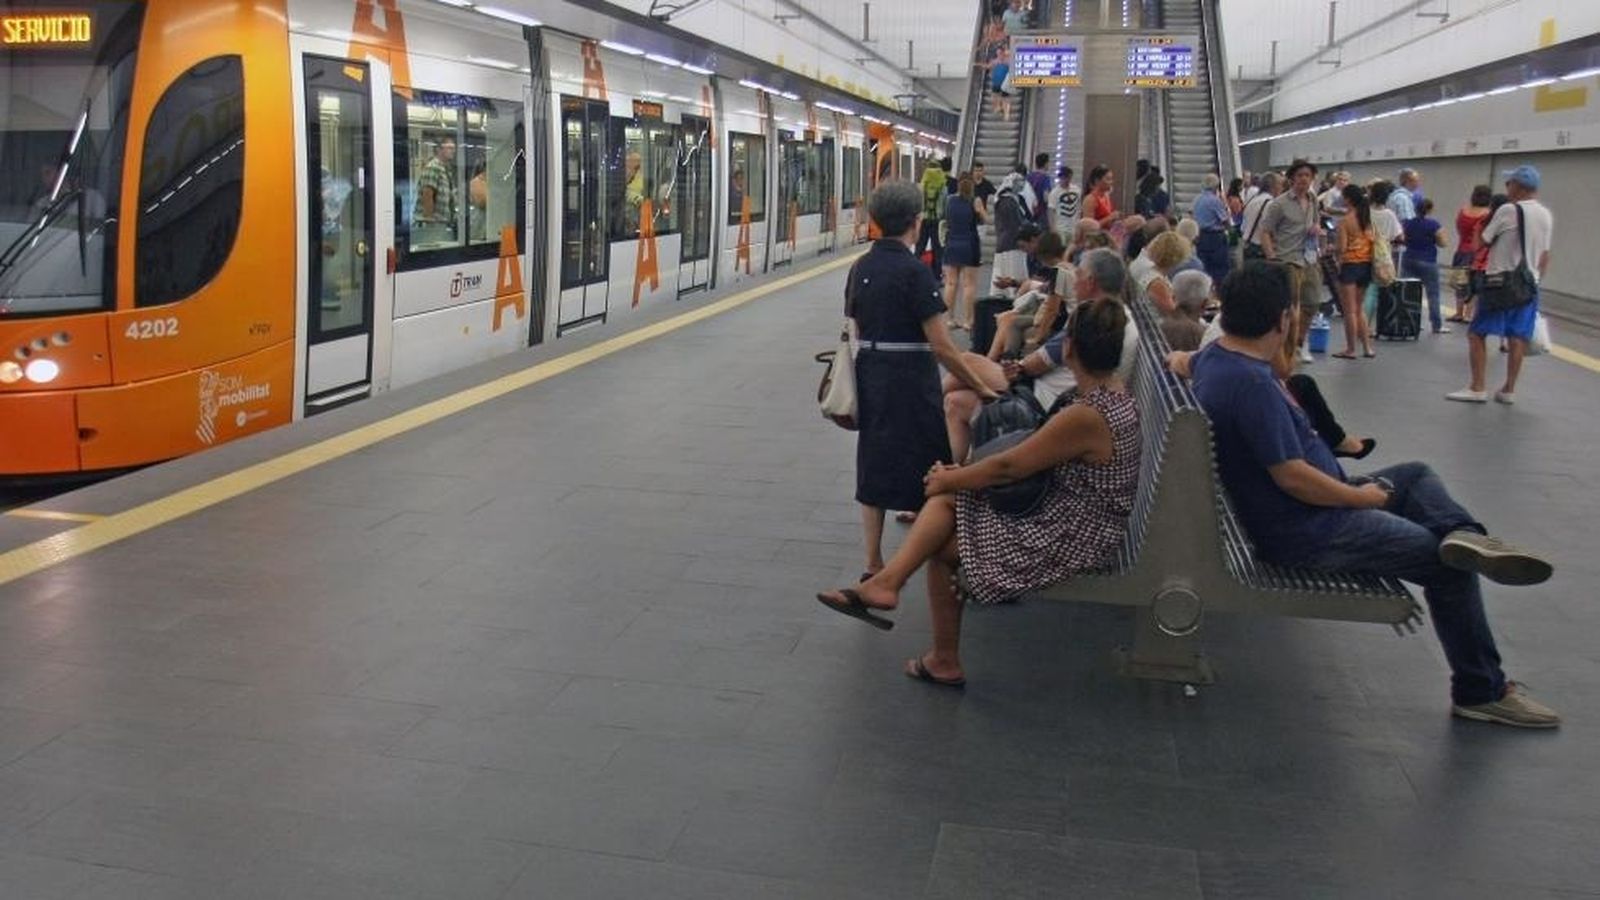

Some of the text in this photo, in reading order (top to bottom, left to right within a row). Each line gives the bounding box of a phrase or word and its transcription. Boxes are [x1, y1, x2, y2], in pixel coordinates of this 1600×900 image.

[3, 15, 91, 44] SERVICIO
[125, 317, 179, 339] 4202
[219, 383, 270, 407] mobilitat
